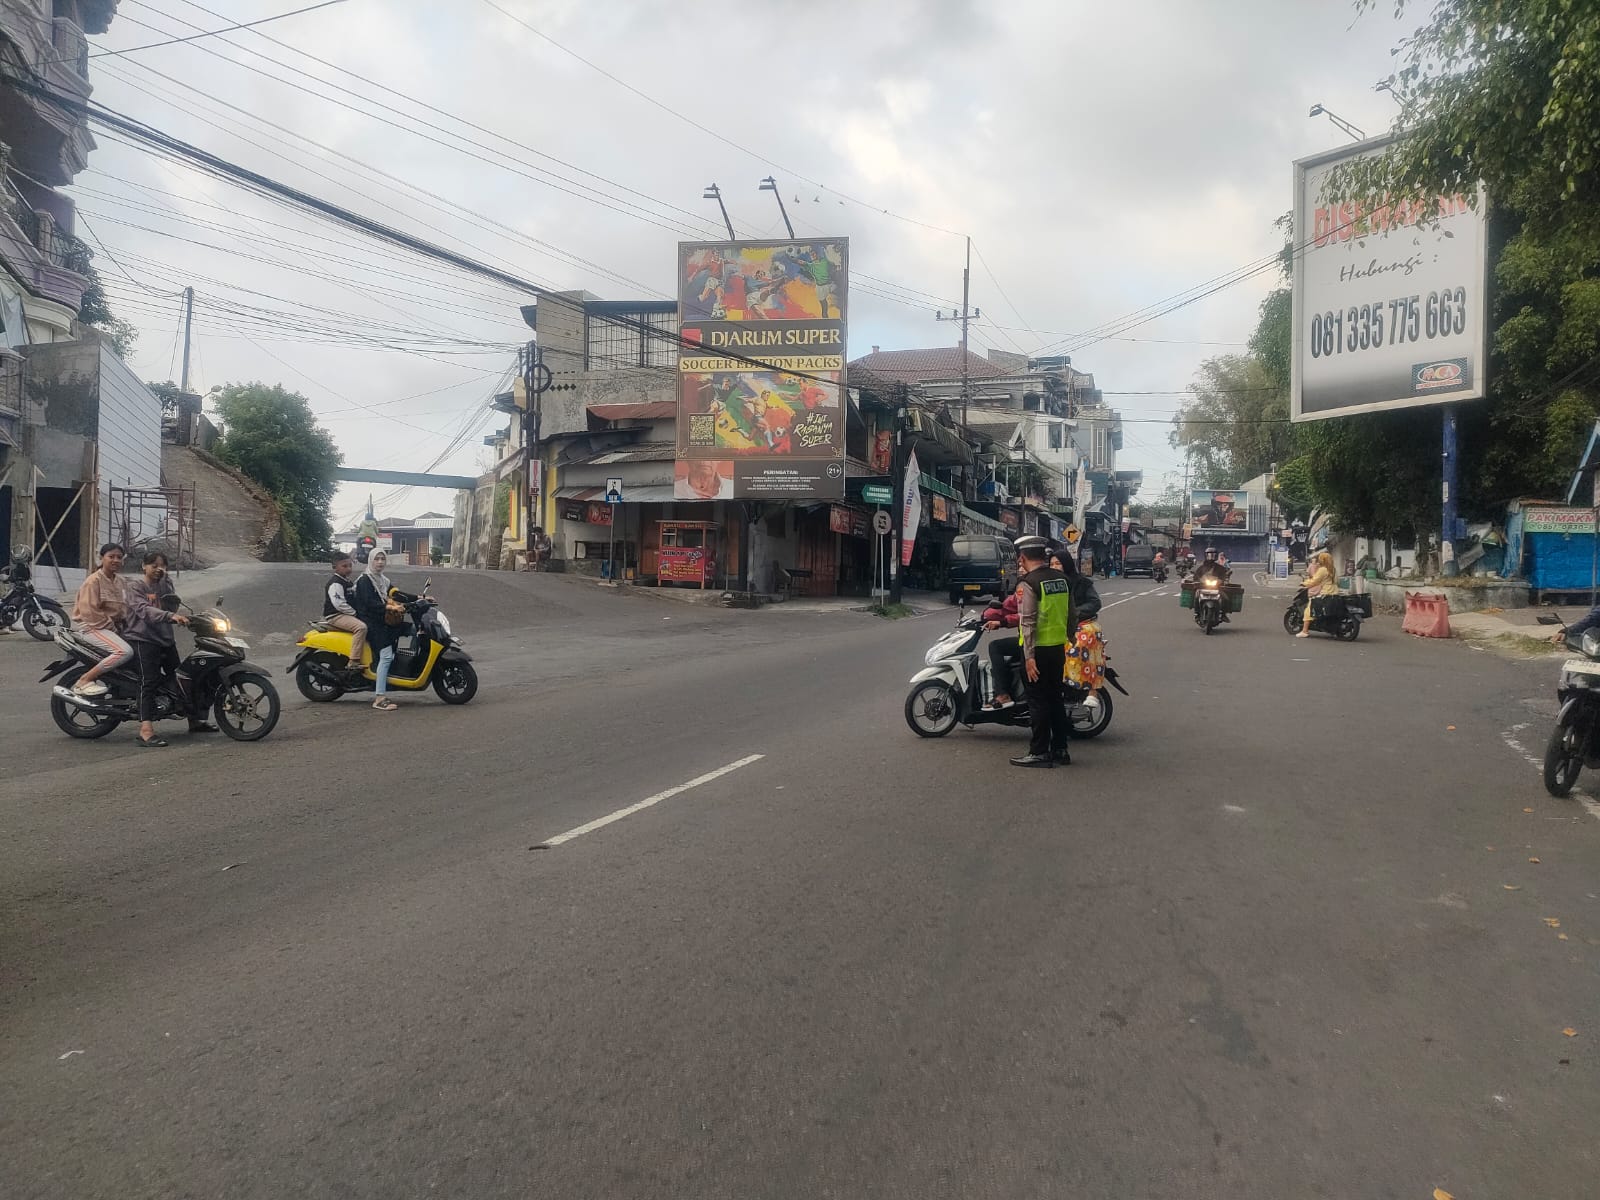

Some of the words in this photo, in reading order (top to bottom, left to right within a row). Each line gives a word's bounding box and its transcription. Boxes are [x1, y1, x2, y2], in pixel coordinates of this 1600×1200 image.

[1340, 252, 1424, 282] Hubungi
[1311, 309, 1344, 359] 081
[1347, 301, 1384, 353] 335
[1388, 295, 1421, 346] 775
[1425, 286, 1467, 340] 663
[711, 330, 783, 348] DJARUM
[785, 328, 842, 346] SUPER
[682, 358, 732, 370] SOCCER
[796, 356, 841, 369] PACKS
[799, 433, 833, 447] SUPER
[828, 467, 840, 475] 21+
[1527, 513, 1553, 523] PAK
[1044, 580, 1067, 594] POLISI
